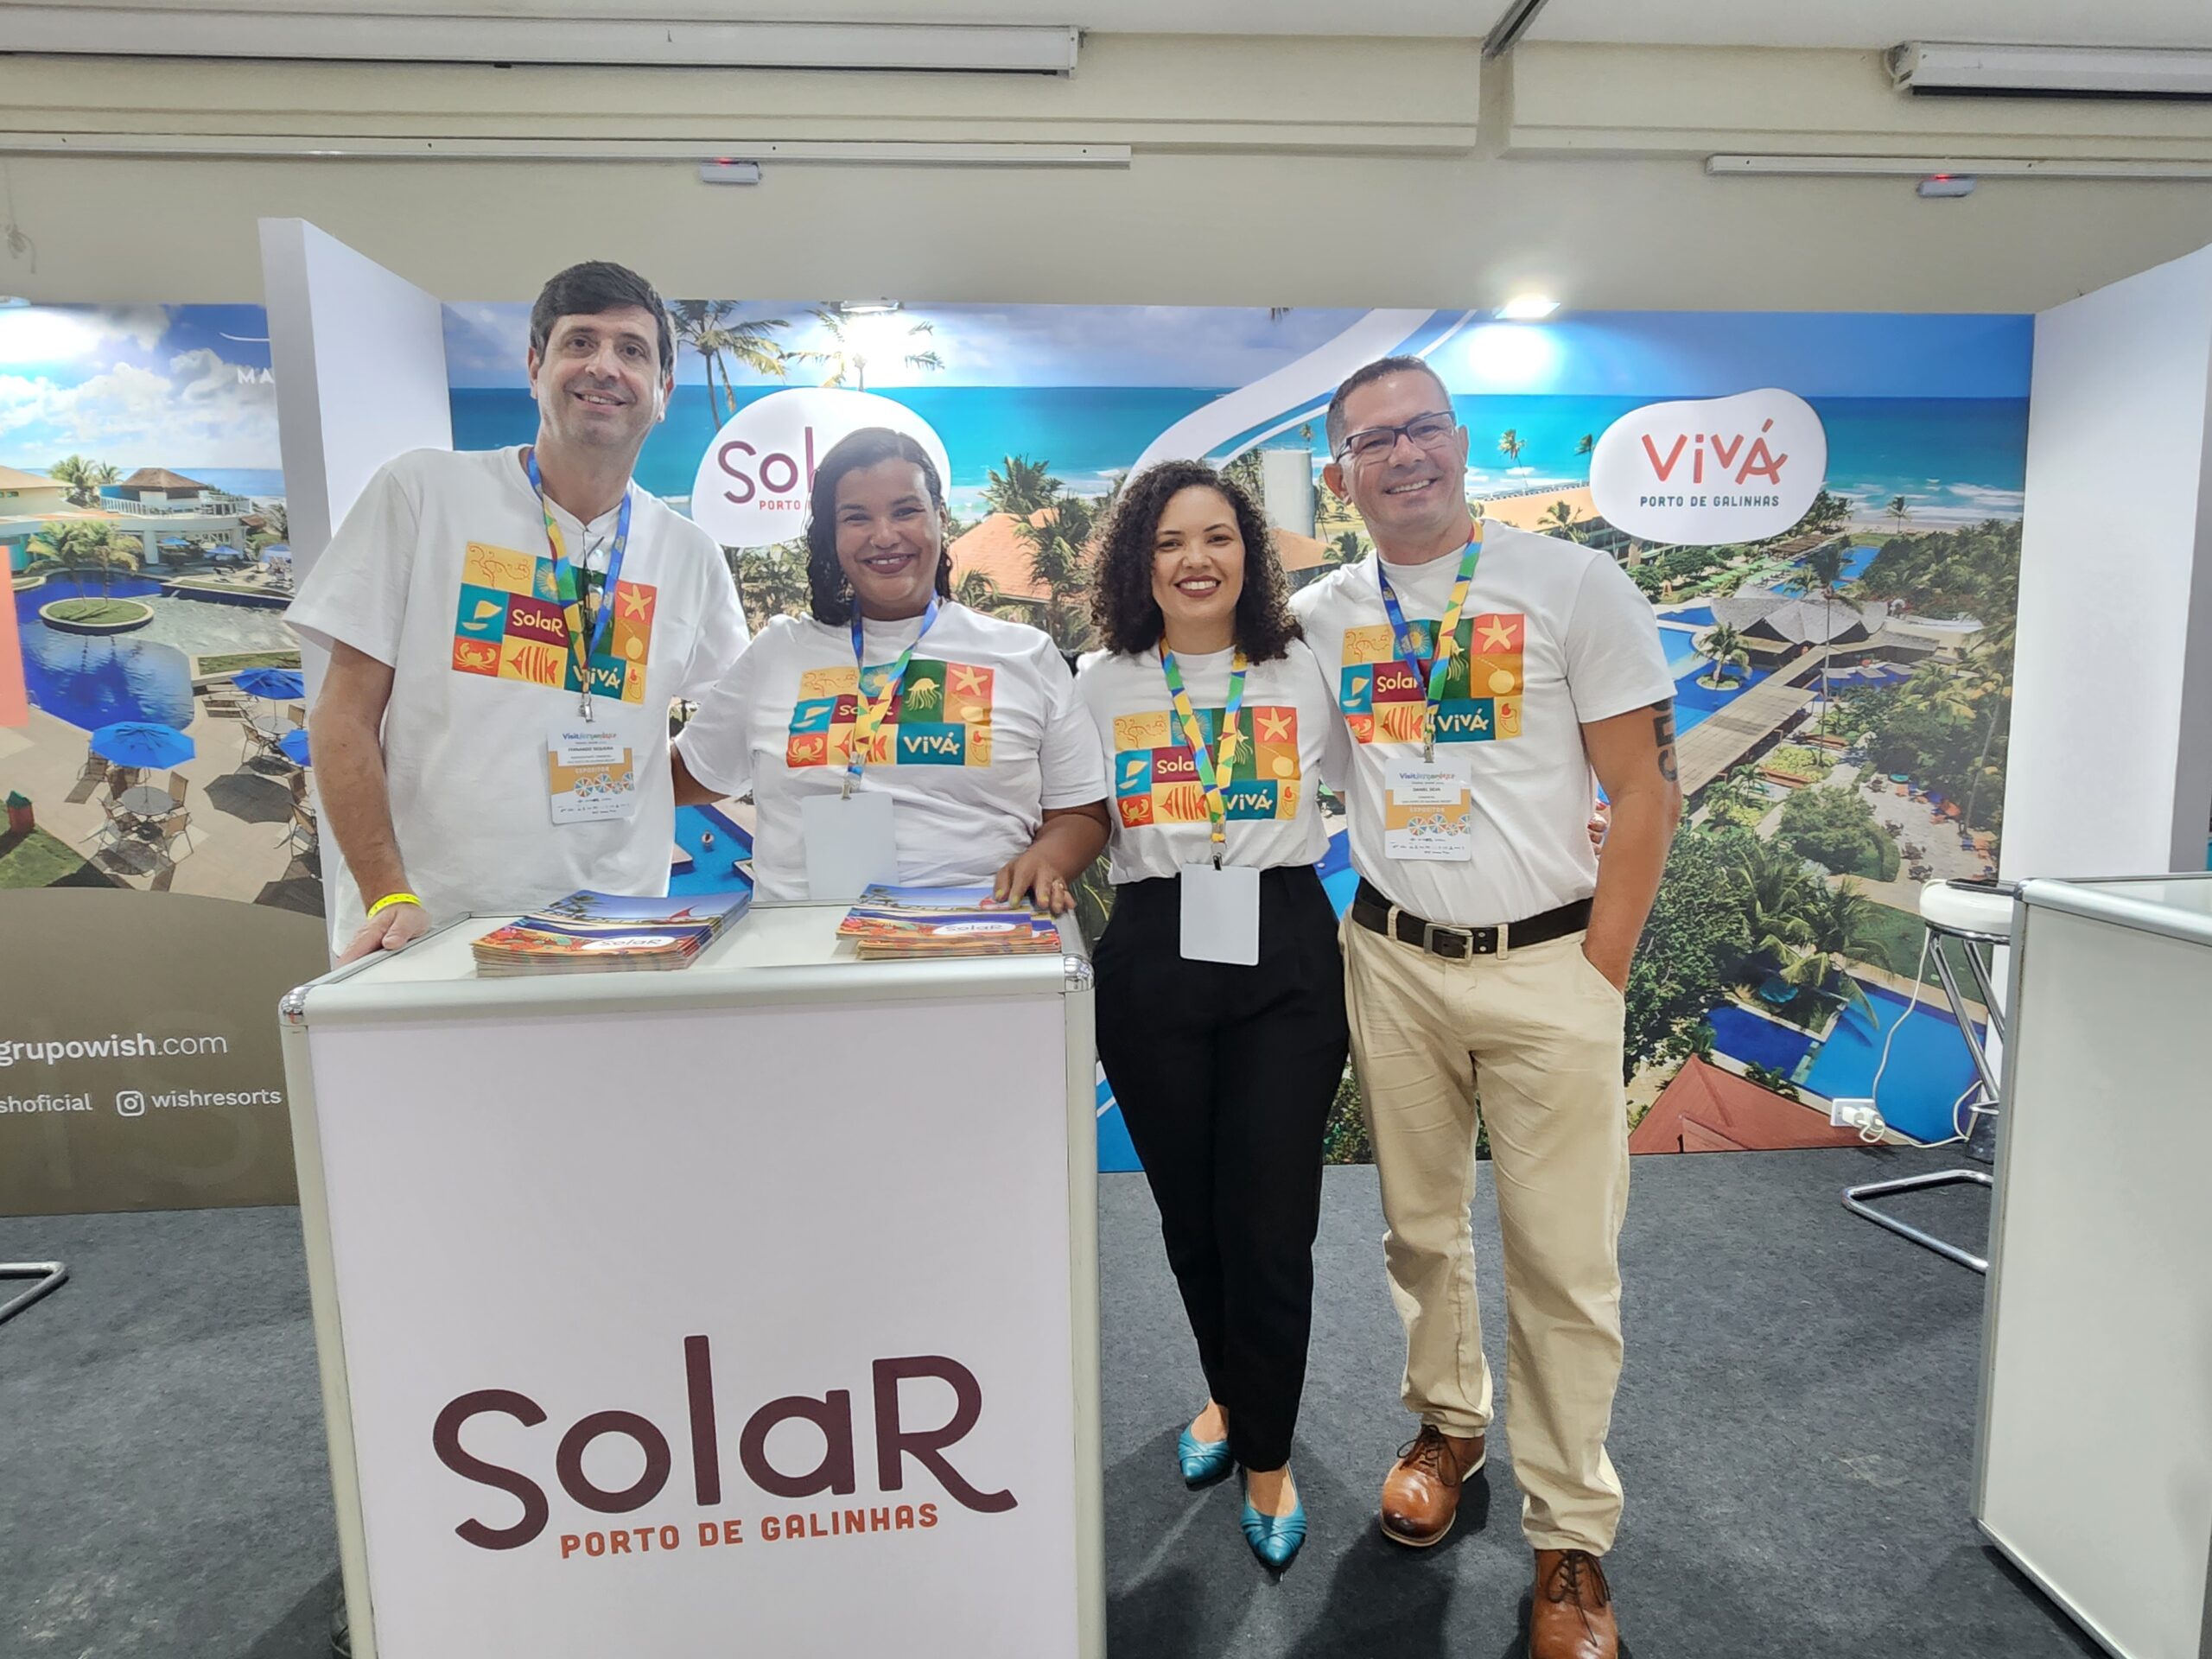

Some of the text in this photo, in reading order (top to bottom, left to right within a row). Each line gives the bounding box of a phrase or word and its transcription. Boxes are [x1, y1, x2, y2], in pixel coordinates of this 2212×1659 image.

[718, 426, 815, 504] Sol
[759, 500, 801, 511] PORTO
[1640, 495, 1780, 507] PORTO DE GALINHAS
[1157, 755, 1195, 774] Sola
[0, 1033, 228, 1067] grupowish.com
[0, 1089, 283, 1114] shoficial wishresorts
[561, 1503, 939, 1560] PORTO DE GALINHAS
